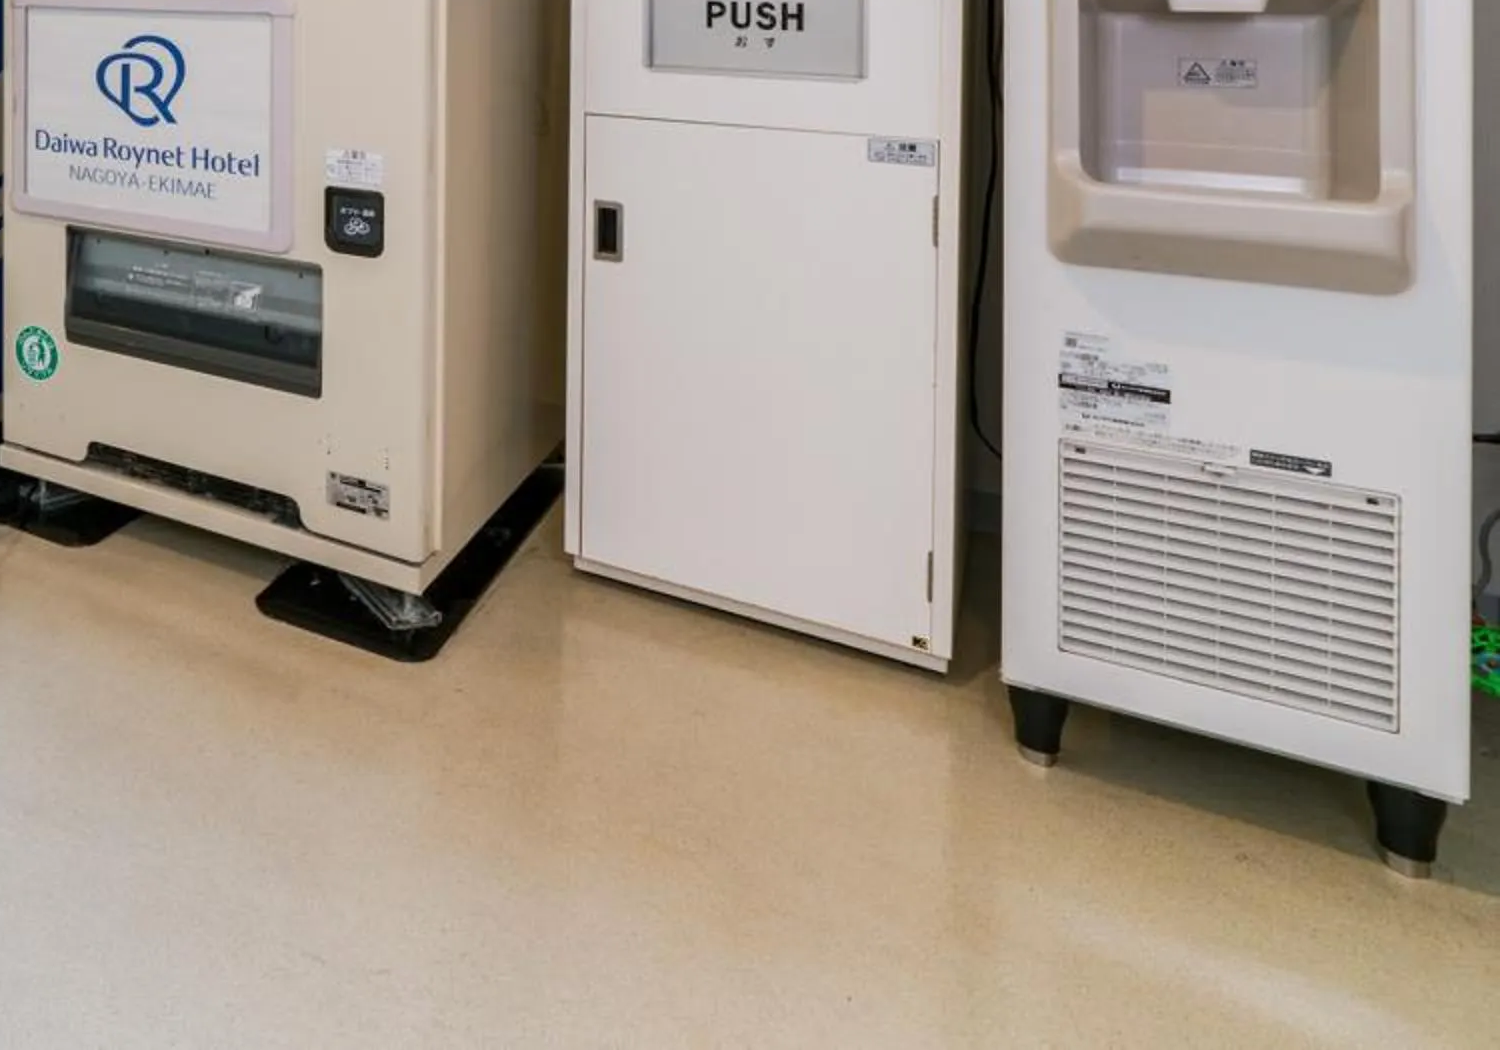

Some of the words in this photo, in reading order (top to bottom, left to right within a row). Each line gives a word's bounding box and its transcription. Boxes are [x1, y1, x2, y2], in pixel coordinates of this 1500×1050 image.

[706, 0, 806, 32] PUSH
[35, 129, 97, 158] Daiwa
[103, 137, 184, 169] Roynet
[191, 147, 260, 177] Hotel
